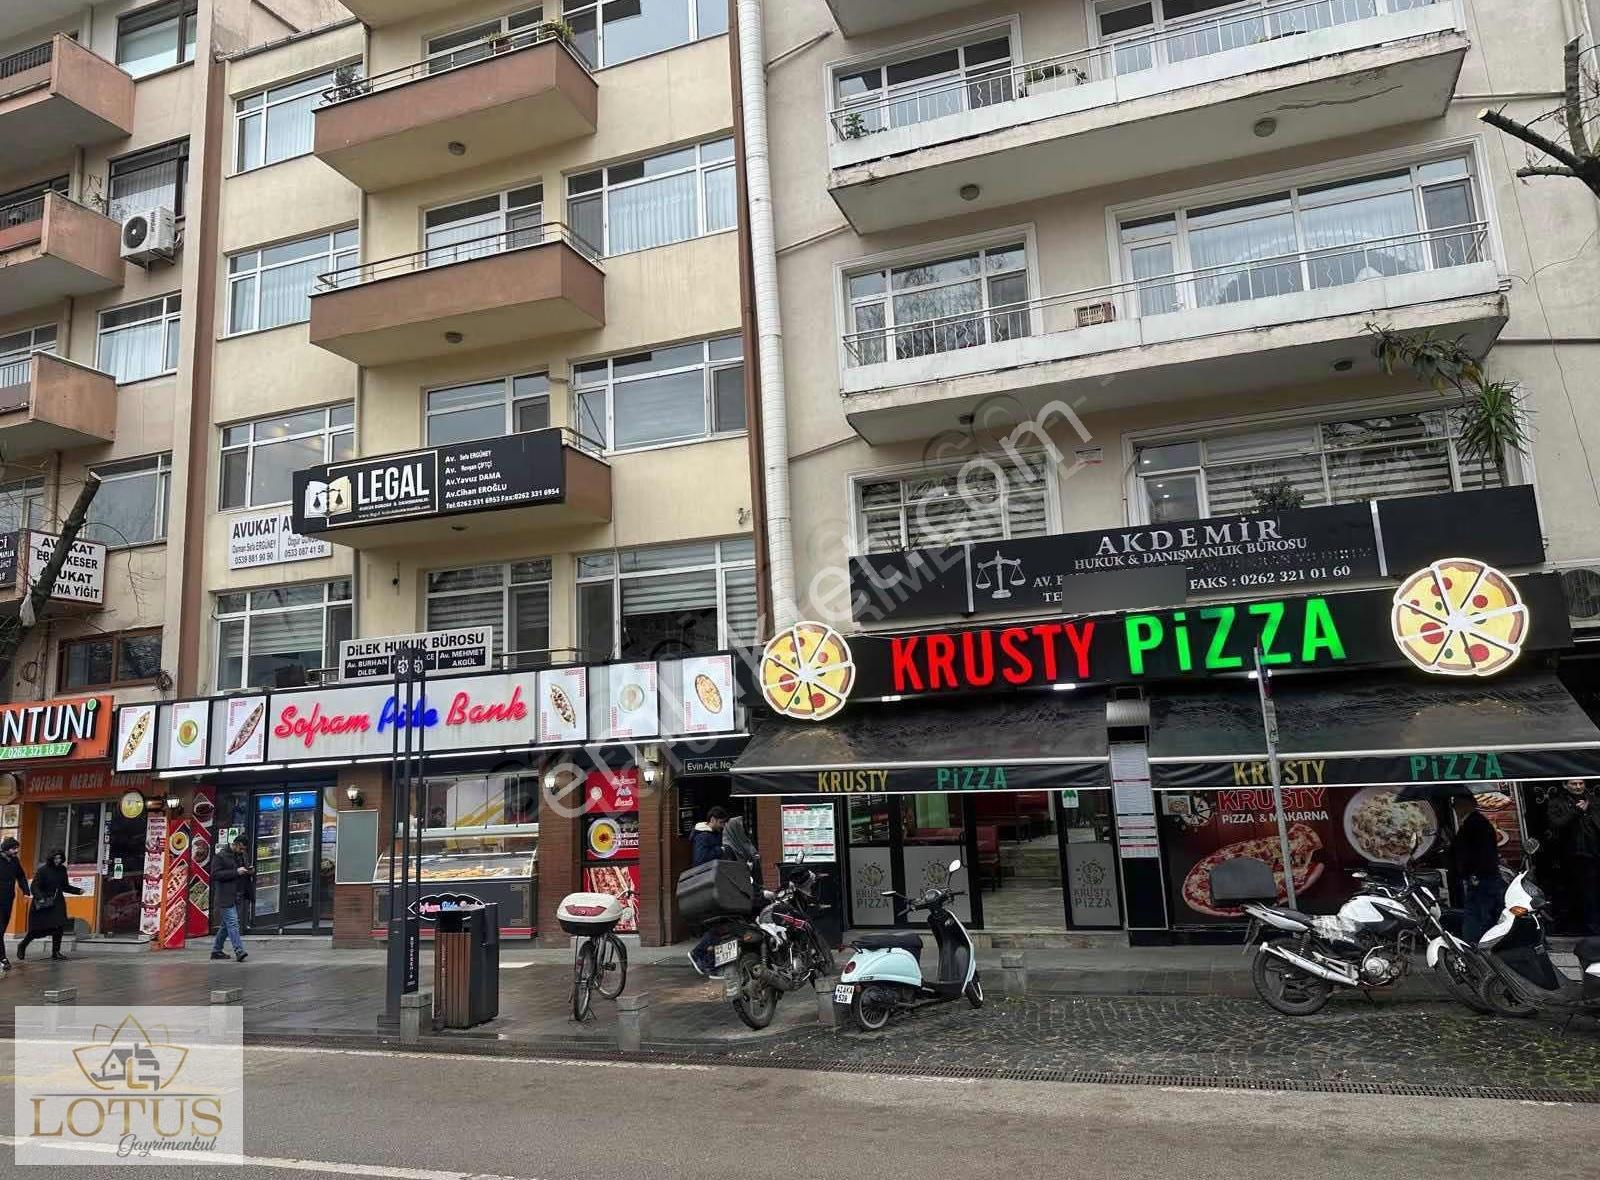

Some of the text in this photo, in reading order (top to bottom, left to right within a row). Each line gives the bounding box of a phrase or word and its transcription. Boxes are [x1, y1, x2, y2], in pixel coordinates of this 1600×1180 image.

[358, 463, 430, 504] LEGAL
[445, 472, 501, 486] Av.Yavuz DAMA
[446, 484, 508, 499] Av.Cihan EROĞLU
[232, 518, 277, 539] AVUKAT
[1095, 517, 1282, 556] AKDEMİR
[42, 538, 95, 555] AVKAT
[1075, 538, 1308, 570] HUKUK & DANIŞMANLIK BÜROSU
[67, 555, 98, 569] KESER
[1033, 576, 1053, 587] AV.
[1189, 577, 1228, 590] FAKS
[1240, 572, 1275, 586] 0262
[1279, 570, 1305, 582] 321
[1310, 568, 1327, 579] 01
[1333, 566, 1350, 577] 60
[73, 584, 99, 599] YİĞİT
[385, 639, 428, 653] HUKUK
[432, 632, 485, 649] BÜROSU
[451, 649, 484, 658] MEHMET
[891, 621, 1096, 692] KRUSTY
[358, 658, 387, 668] BURHAN
[452, 658, 477, 667] AKGÜL
[274, 702, 370, 748] Sofram
[446, 684, 528, 726] Bank
[687, 762, 703, 771] Evin
[817, 770, 889, 793] KRUSTY
[1259, 813, 1267, 823] &
